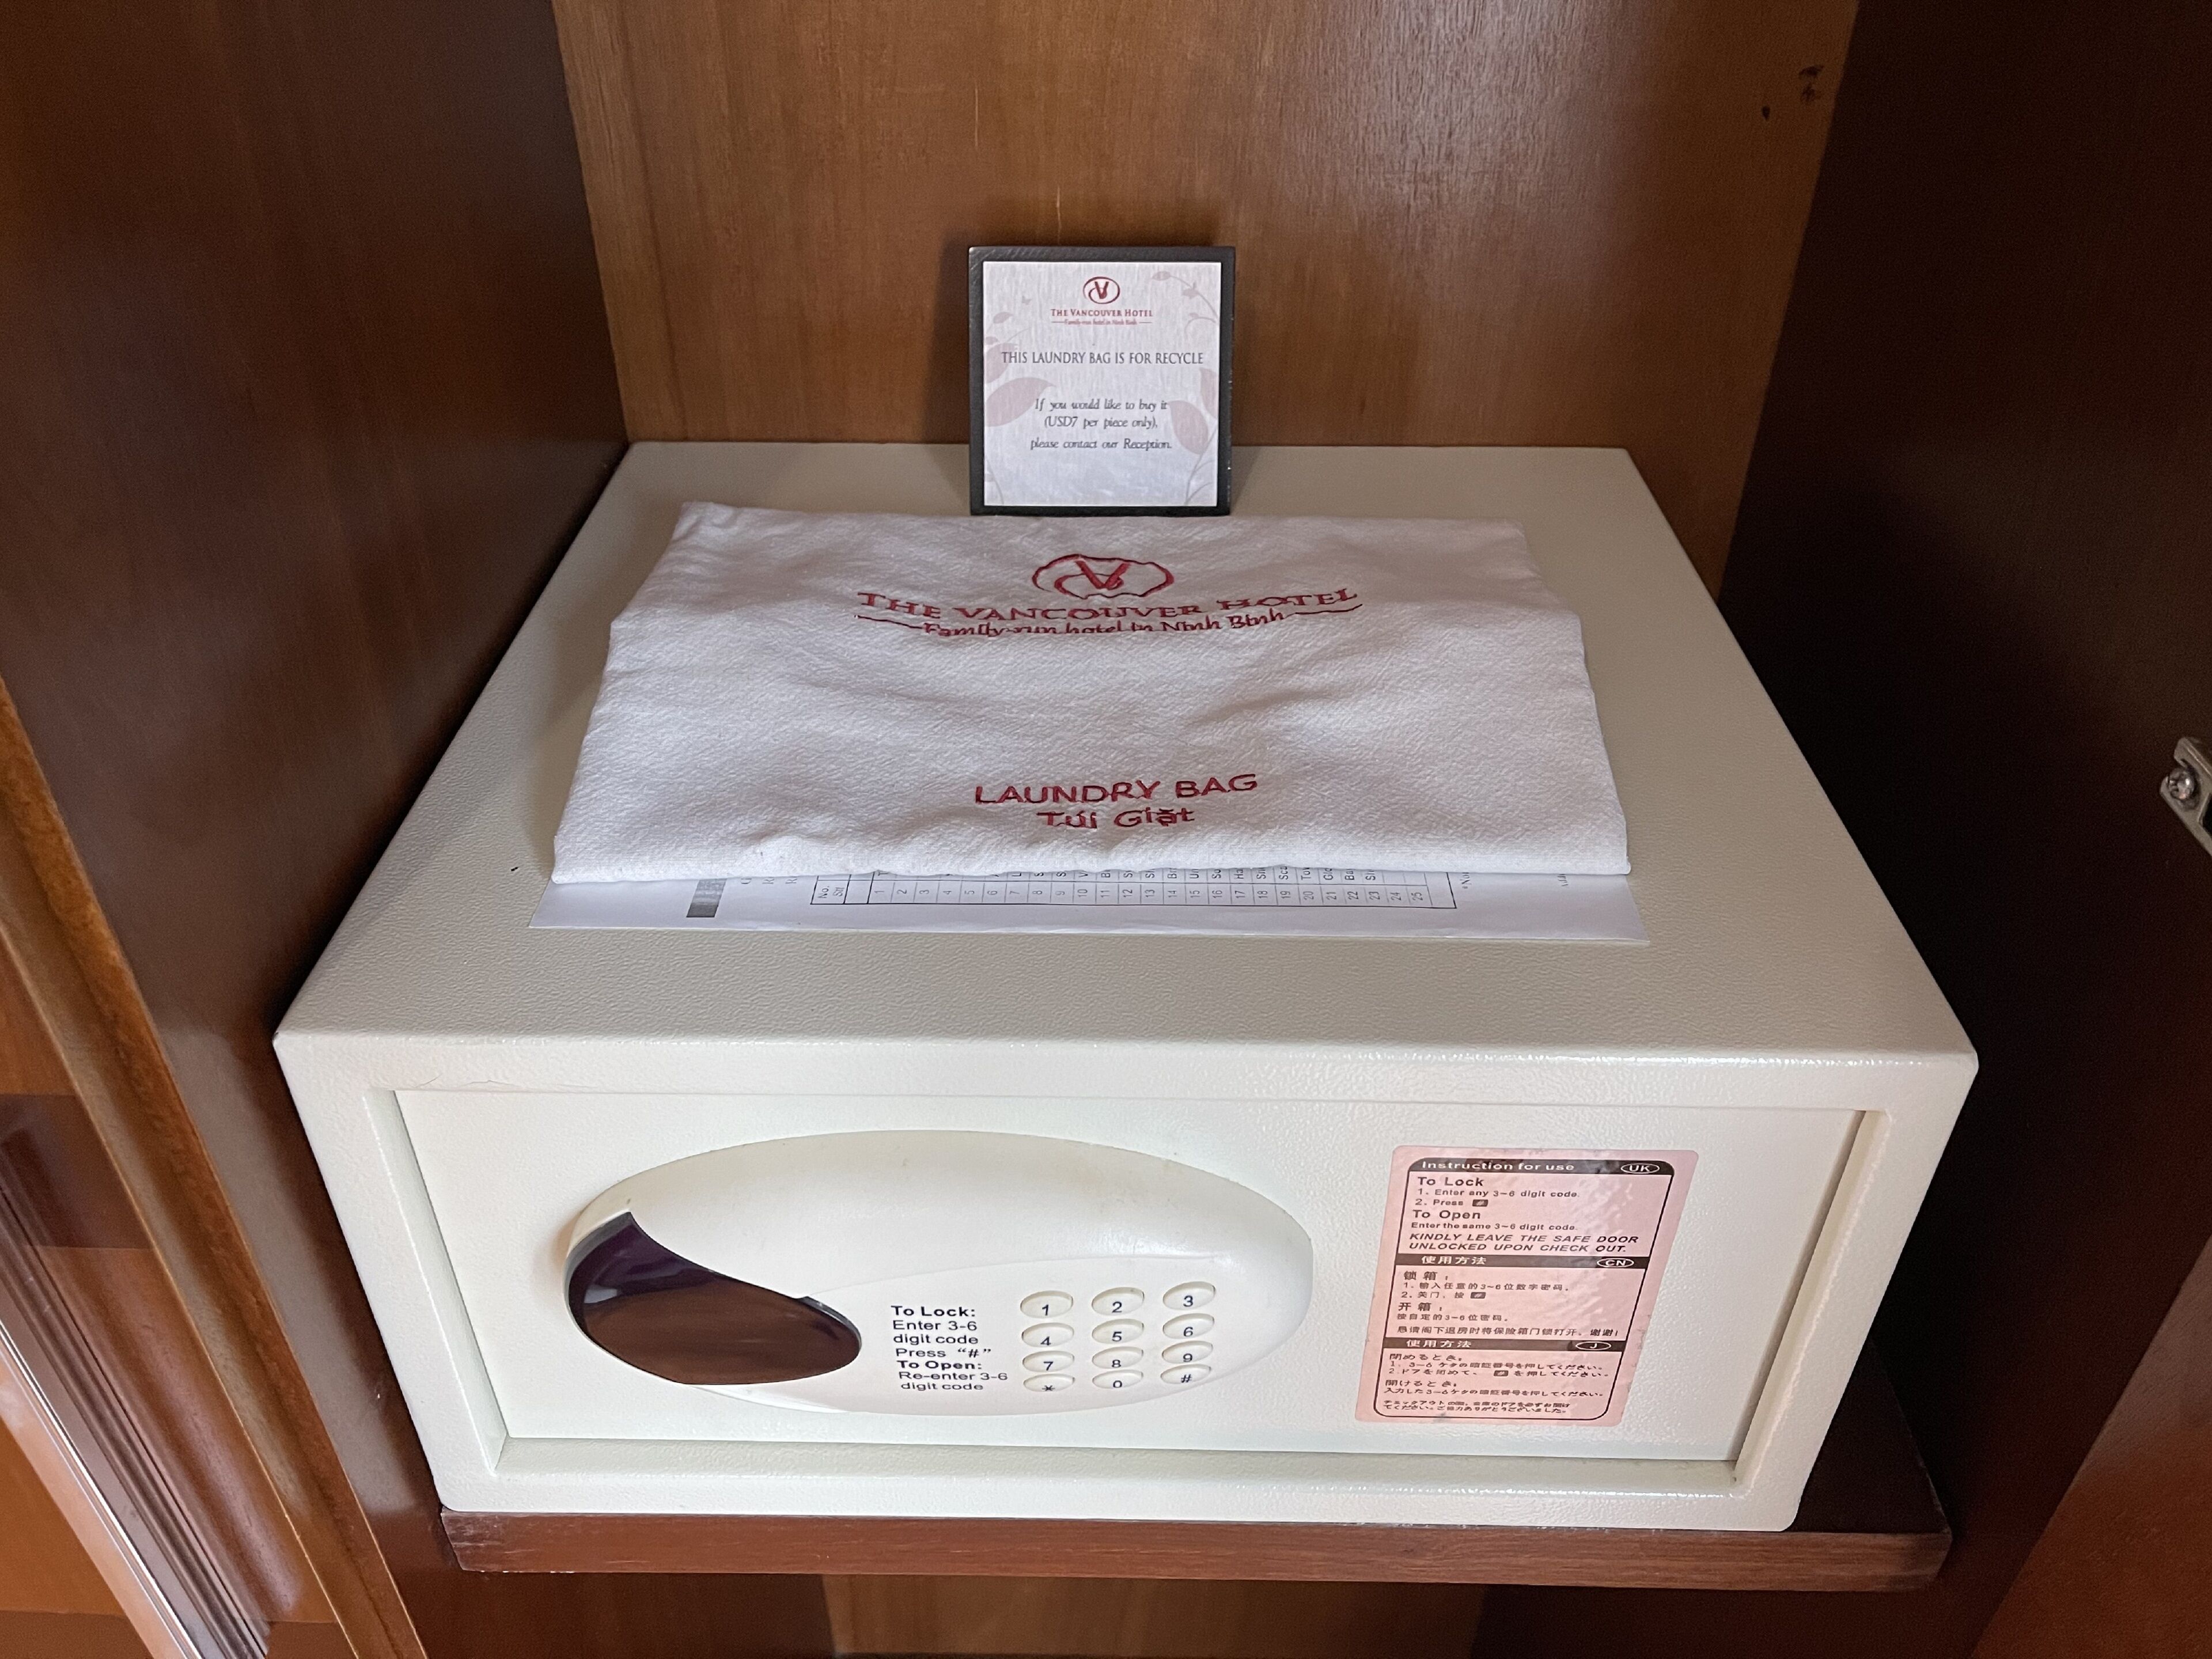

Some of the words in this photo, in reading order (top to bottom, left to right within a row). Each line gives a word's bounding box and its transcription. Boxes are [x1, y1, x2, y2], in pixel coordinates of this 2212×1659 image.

[1001, 351, 1028, 363] THIS
[1032, 351, 1086, 364] LAUNDRY
[1090, 351, 1111, 364] BAG
[1115, 352, 1124, 364] IS
[1130, 352, 1151, 364] FOR
[1156, 352, 1203, 365] RECYCLE
[1035, 399, 1045, 411] If
[1050, 403, 1066, 411] you
[1071, 399, 1100, 409] would
[1104, 399, 1121, 409] like
[1139, 399, 1156, 412] buy
[1161, 400, 1167, 409] it
[1044, 416, 1078, 428] (USD7
[1083, 418, 1099, 429] per
[1103, 417, 1127, 429] piece
[1031, 437, 1059, 449] please
[1063, 439, 1097, 449] contact
[1102, 440, 1118, 448] our
[1123, 438, 1172, 451] Reception.
[858, 592, 941, 619] THE
[953, 605, 1208, 621] VANCOUVER
[1216, 588, 1357, 610] HOTEL
[1066, 620, 1122, 634] hotel
[1161, 615, 1221, 631] Ninh
[1227, 608, 1284, 629] Binh
[975, 780, 1160, 804] LAUNDRY
[1176, 774, 1258, 799] BAG
[1037, 808, 1097, 829] Túi
[818, 885, 830, 898] No.
[1078, 889, 1088, 897] 10
[1101, 889, 1110, 897] 11
[1123, 889, 1132, 897] 12
[1145, 889, 1155, 898] 13
[1168, 889, 1177, 898] 14
[1191, 890, 1200, 899] 15
[1212, 890, 1222, 899] 16
[1236, 890, 1245, 899] 17
[1258, 890, 1268, 899] 18
[1281, 891, 1291, 899] 19
[1304, 891, 1314, 900] 20
[1326, 891, 1337, 900] 21
[1349, 891, 1359, 900] 22
[1369, 891, 1380, 900] 23
[1391, 892, 1402, 901] 24
[1411, 892, 1423, 901] 25
[1422, 1161, 1513, 1171] Instruction
[1518, 1162, 1541, 1171] for
[1418, 1176, 1436, 1185] To
[1444, 1177, 1484, 1187] Lock
[1412, 1210, 1431, 1218] To
[1439, 1210, 1481, 1221] Open
[1421, 1256, 1487, 1266] 使用方法
[1604, 1259, 1627, 1267] CN
[1041, 1305, 1050, 1316] 1
[1112, 1302, 1122, 1313] 2
[1183, 1296, 1194, 1307] 3
[891, 1305, 915, 1316] To
[921, 1306, 975, 1317] Lock:
[893, 1320, 941, 1330] Enter
[948, 1320, 978, 1331] 3-6
[893, 1334, 931, 1346] digit
[935, 1335, 979, 1344] code
[1041, 1336, 1051, 1346] 4
[1112, 1332, 1122, 1342] 5
[1183, 1327, 1194, 1336] 6
[1406, 1339, 1471, 1348] 使用方法
[895, 1348, 946, 1357] Press
[896, 1360, 919, 1369] To
[925, 1360, 982, 1371] Open:
[1043, 1361, 1053, 1370] 7
[1111, 1359, 1122, 1368] 8
[1183, 1354, 1193, 1362] 9
[899, 1371, 976, 1380] Re-enter
[980, 1372, 1008, 1381] 3-6
[901, 1382, 938, 1391] digit
[1112, 1380, 1123, 1388] 0
